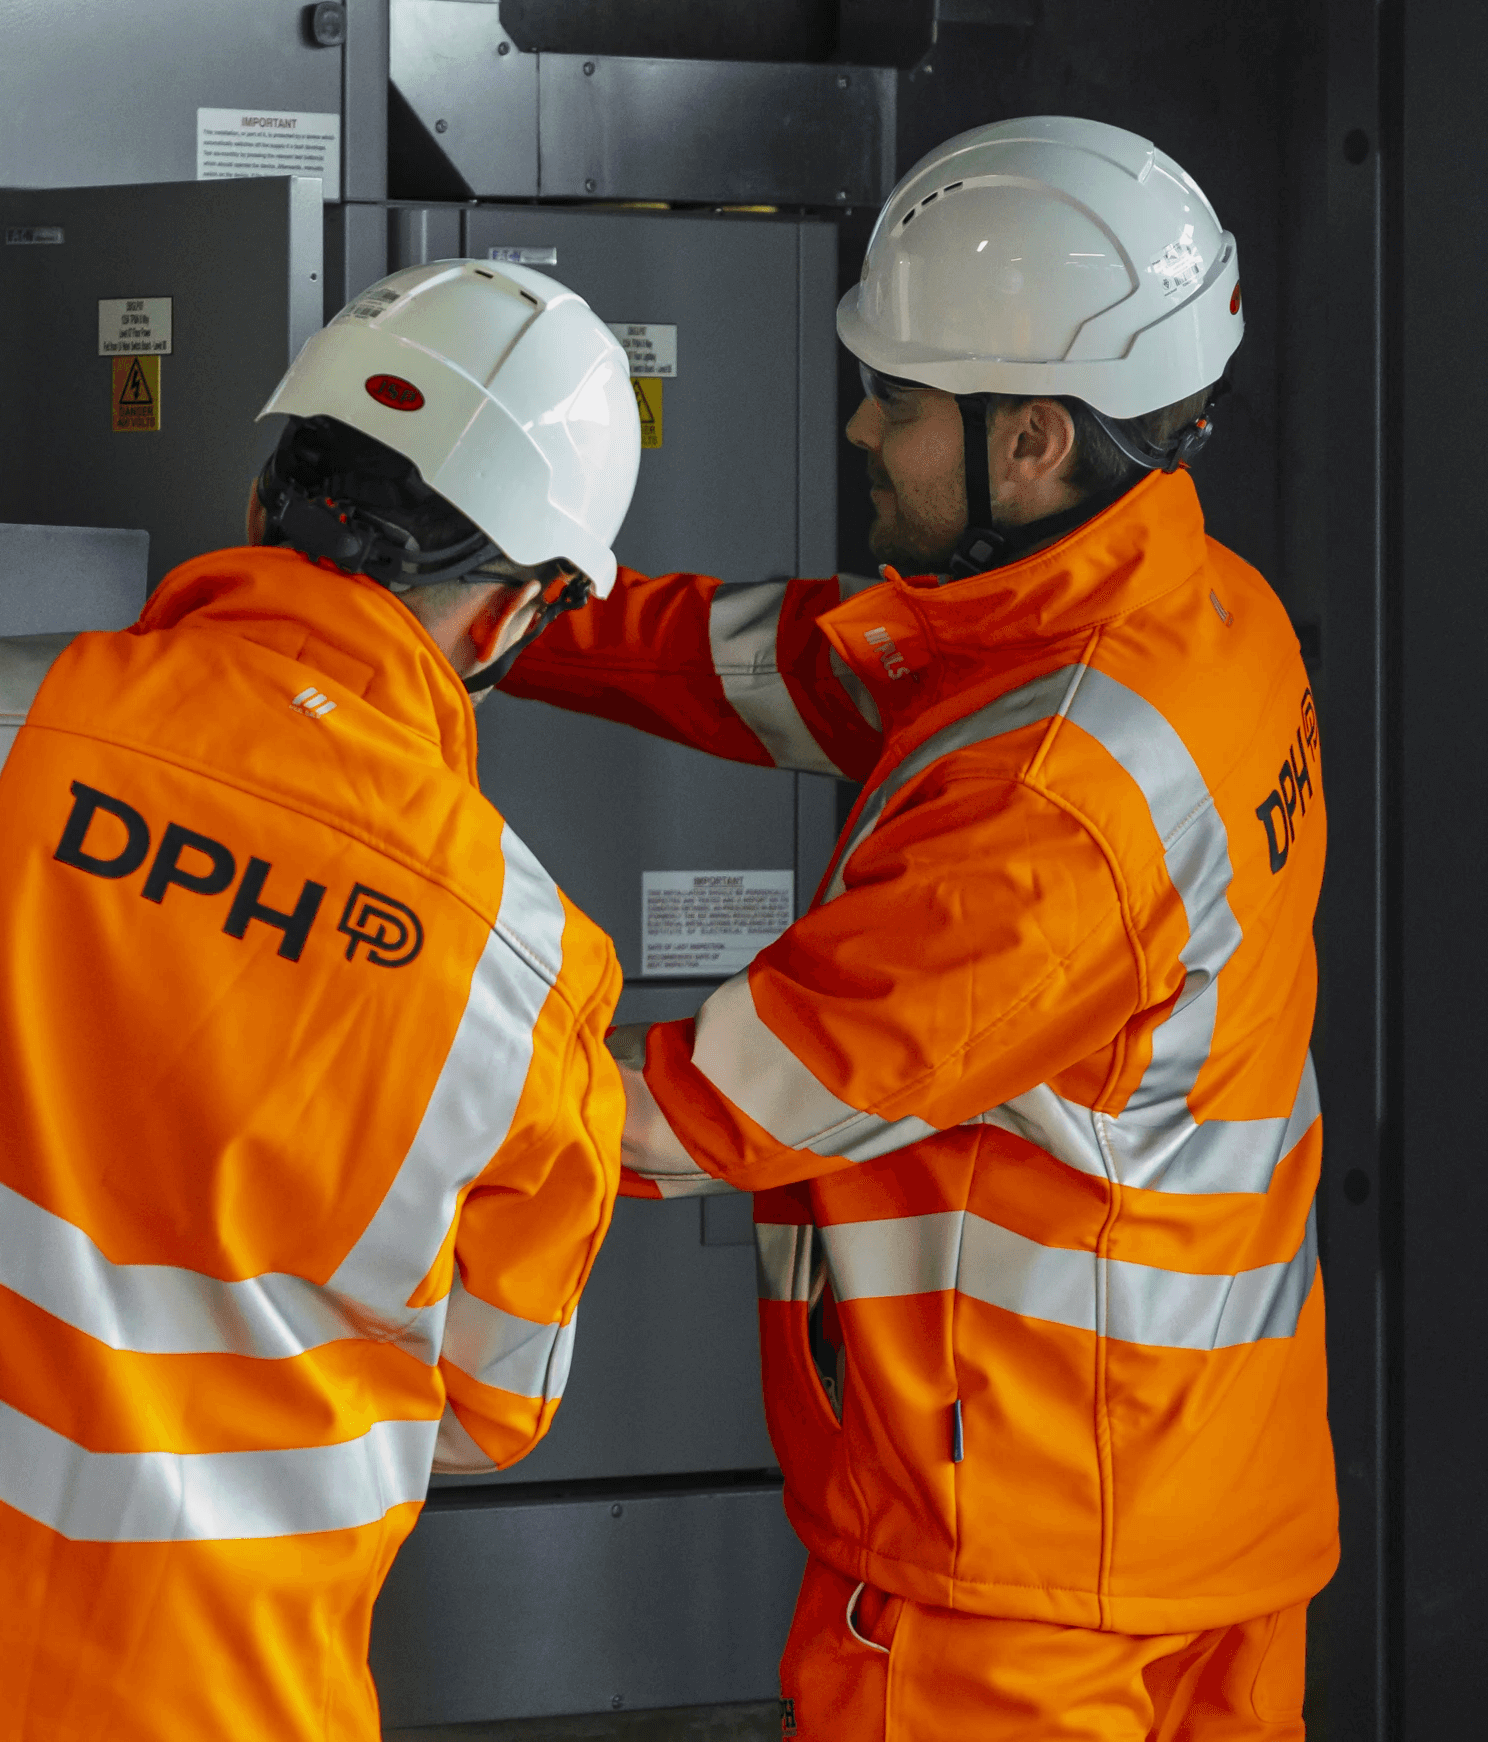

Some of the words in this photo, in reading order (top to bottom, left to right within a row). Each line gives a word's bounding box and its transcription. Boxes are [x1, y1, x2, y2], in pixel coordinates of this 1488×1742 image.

[241, 117, 297, 129] IMPORTANT
[53, 780, 327, 963] DPH
[1255, 726, 1313, 875] DPH
